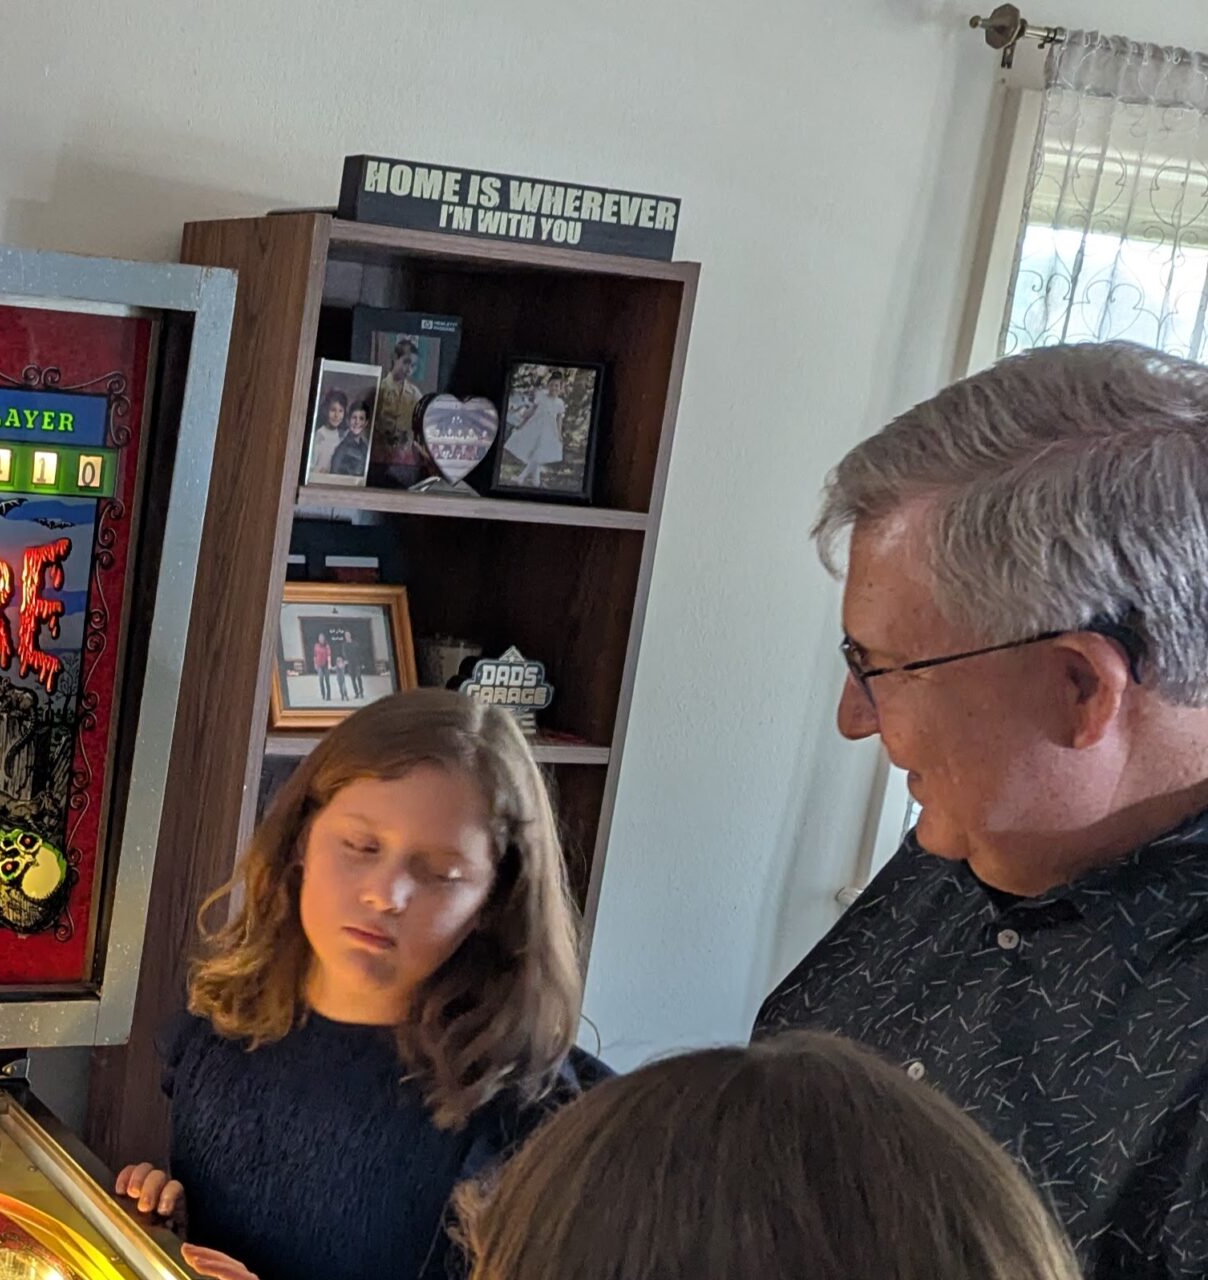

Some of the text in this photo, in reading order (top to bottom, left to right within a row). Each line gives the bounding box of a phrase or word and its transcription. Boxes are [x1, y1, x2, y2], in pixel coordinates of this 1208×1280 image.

[364, 160, 679, 232] HOME IS WHEREVER
[439, 203, 583, 246] I'M WITH YOU
[466, 684, 547, 705] GARAGE
